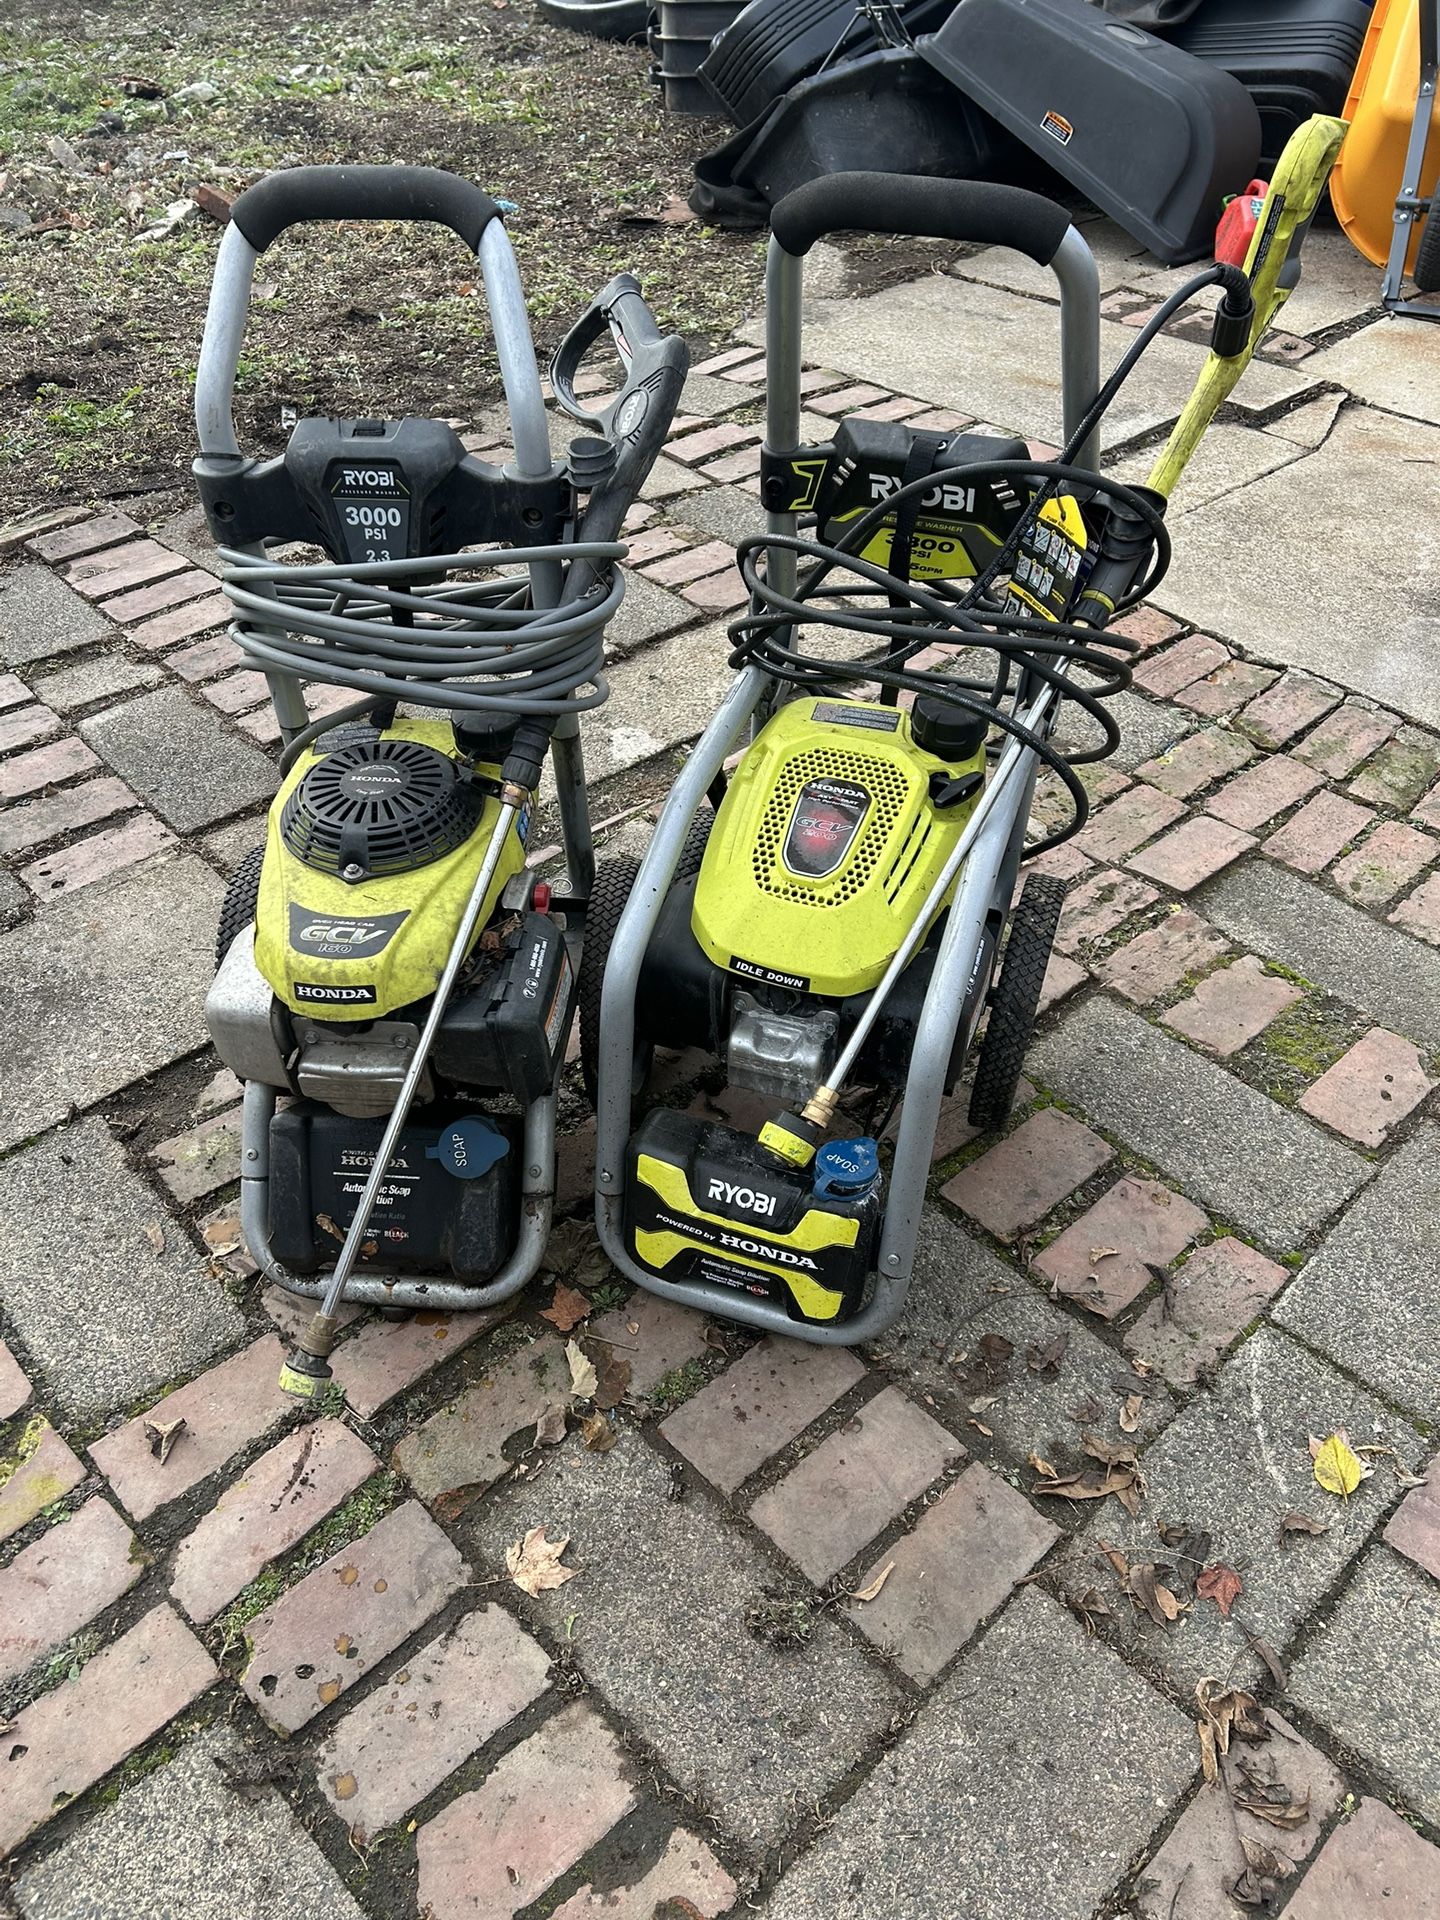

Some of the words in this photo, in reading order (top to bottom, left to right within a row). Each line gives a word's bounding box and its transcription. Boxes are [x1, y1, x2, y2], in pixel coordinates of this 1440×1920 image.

[619, 394, 641, 433] RYOBI
[343, 470, 395, 486] RYOBI
[345, 506, 402, 527] 3000
[364, 527, 387, 540] PSI
[925, 522, 964, 533] WASHER
[366, 549, 391, 562] 2.3
[810, 782, 867, 799] HONDA
[796, 816, 854, 833] GCV
[802, 829, 838, 841] 200
[300, 925, 388, 945] GCV
[317, 943, 353, 954] 160
[735, 961, 764, 977] IDLE
[766, 972, 804, 988] DOWN
[296, 985, 373, 999] HONDA
[452, 1133, 468, 1167] SOAP
[826, 1153, 860, 1174] SOAP
[342, 1182, 388, 1195] Autoic
[707, 1178, 777, 1217] RYOBI
[655, 1213, 703, 1235] POWERED
[703, 1231, 717, 1241] by
[719, 1232, 819, 1271] HONDA
[700, 1258, 731, 1271] Automatic
[731, 1267, 747, 1276] Soap
